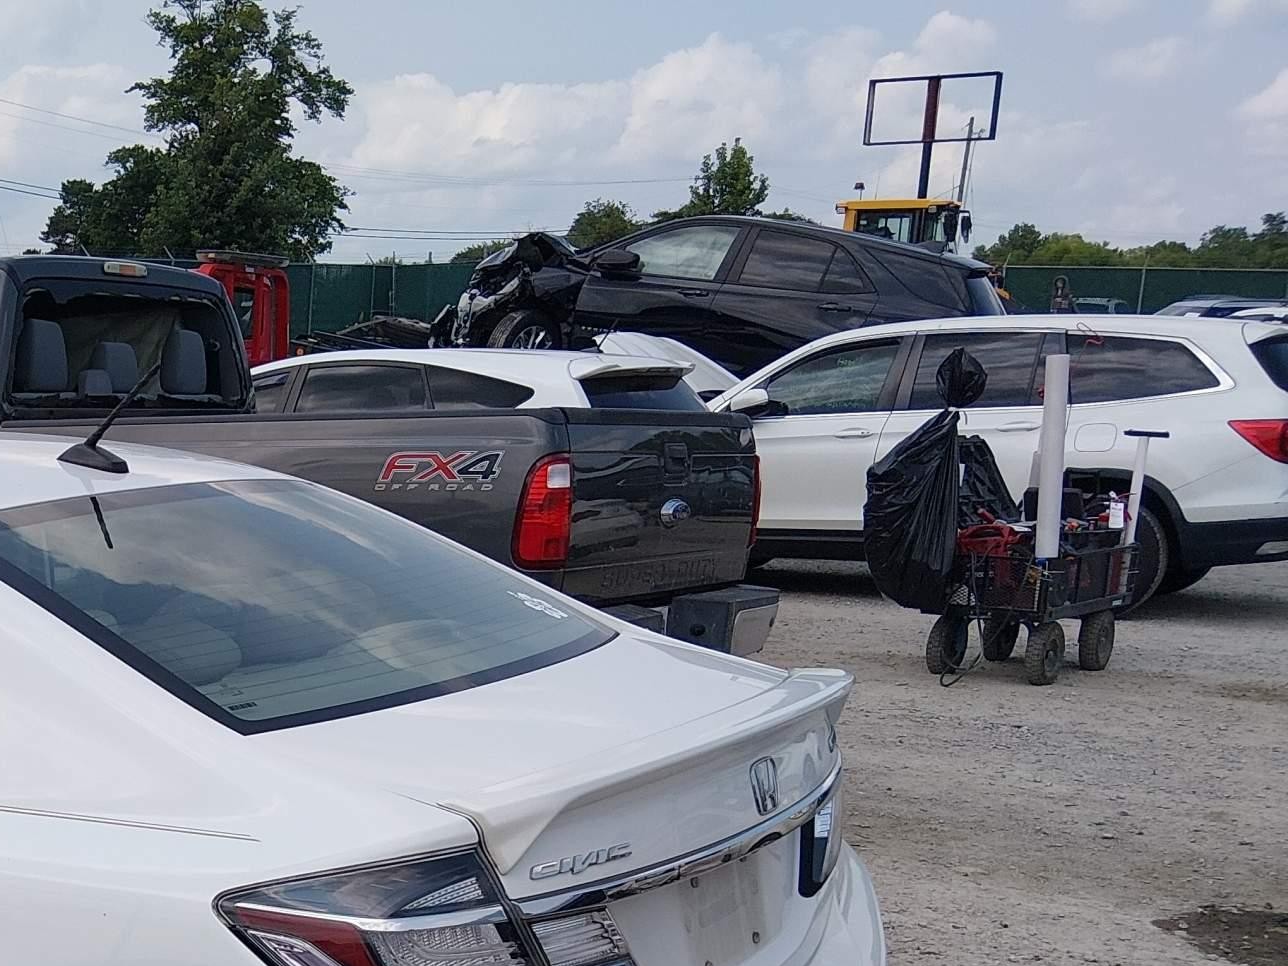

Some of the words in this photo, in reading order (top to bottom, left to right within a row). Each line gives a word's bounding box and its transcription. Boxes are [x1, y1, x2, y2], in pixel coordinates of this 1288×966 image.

[377, 450, 505, 483] FX4
[374, 483, 419, 491] OFF
[428, 483, 494, 491] ROAD
[529, 842, 632, 880] CIVIC
